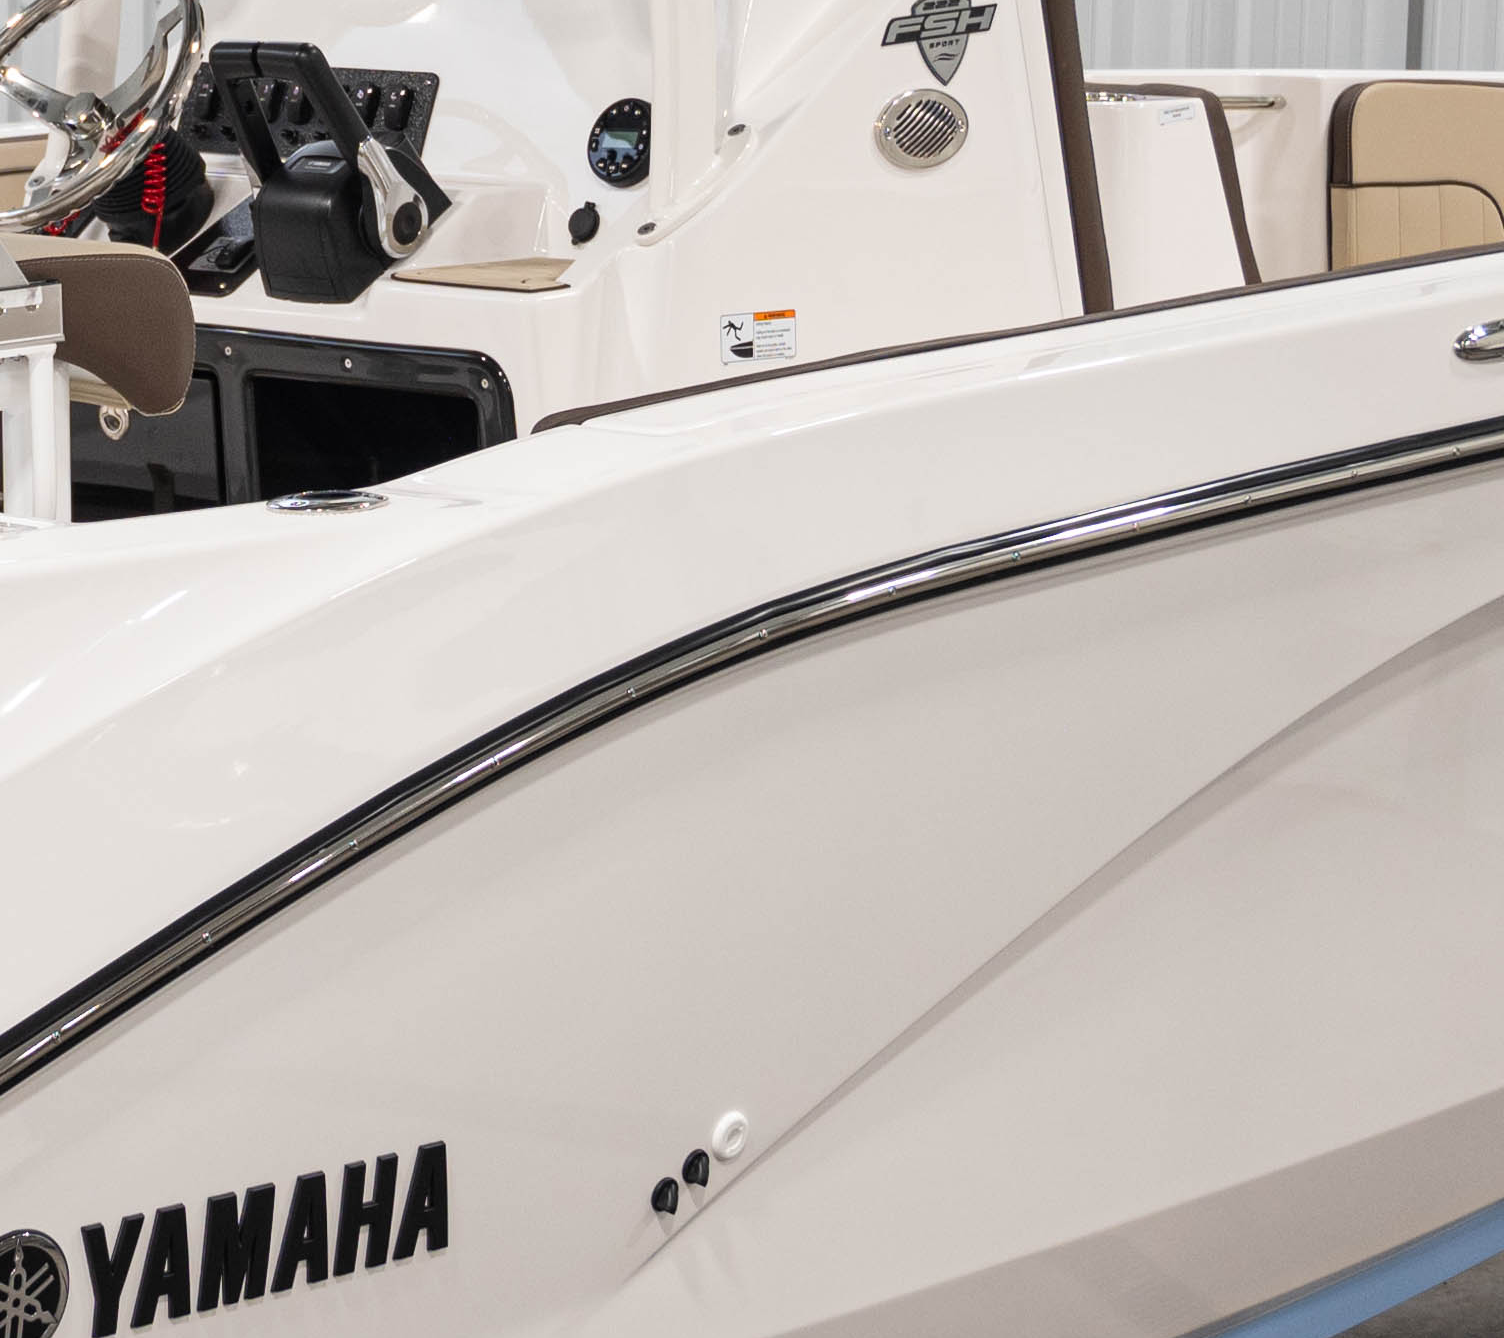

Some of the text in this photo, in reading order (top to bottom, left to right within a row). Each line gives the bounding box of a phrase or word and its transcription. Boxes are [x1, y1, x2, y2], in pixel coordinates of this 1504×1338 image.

[884, 5, 995, 43] FSH
[929, 39, 960, 49] SPORT
[80, 1141, 449, 1338] YAMAHA
